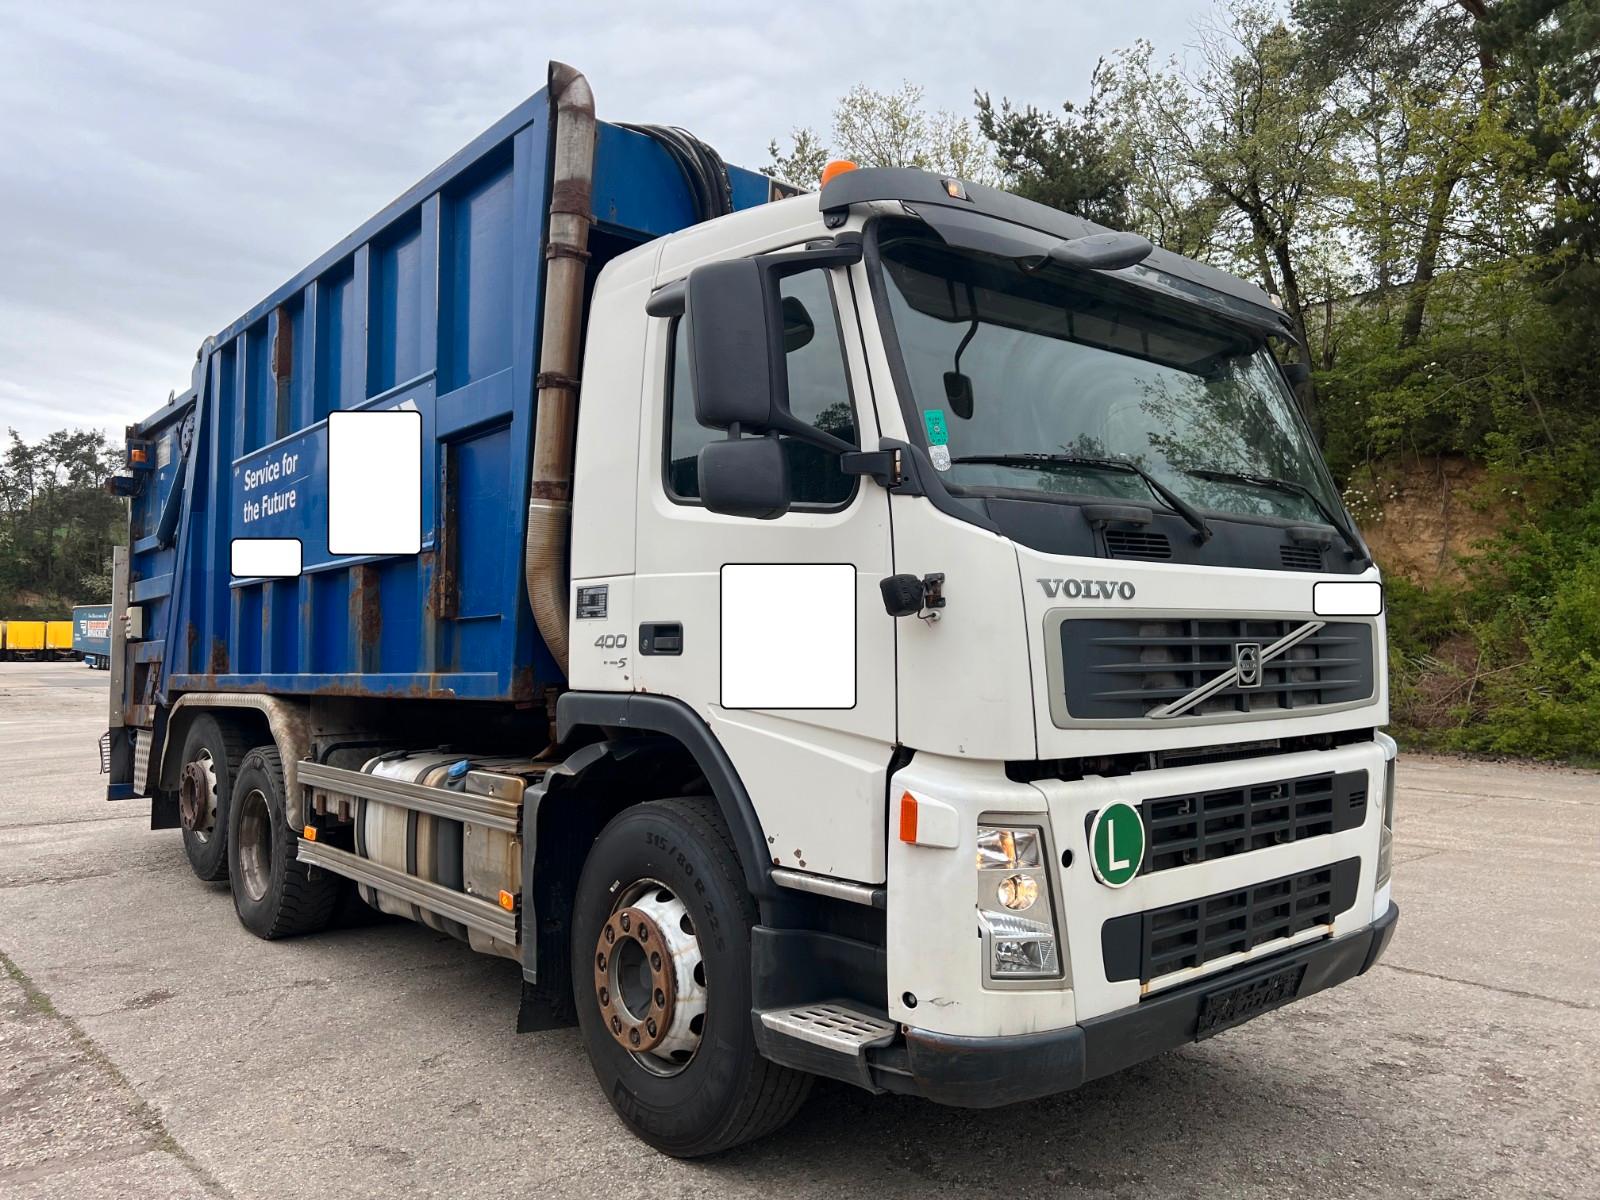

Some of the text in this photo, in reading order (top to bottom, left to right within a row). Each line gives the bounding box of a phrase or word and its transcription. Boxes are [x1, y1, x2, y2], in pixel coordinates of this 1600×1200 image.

[244, 452, 298, 491] Service for
[243, 489, 296, 523] the Future
[1036, 578, 1136, 600] VOLVO
[594, 634, 628, 649] 400
[1107, 819, 1131, 871] L
